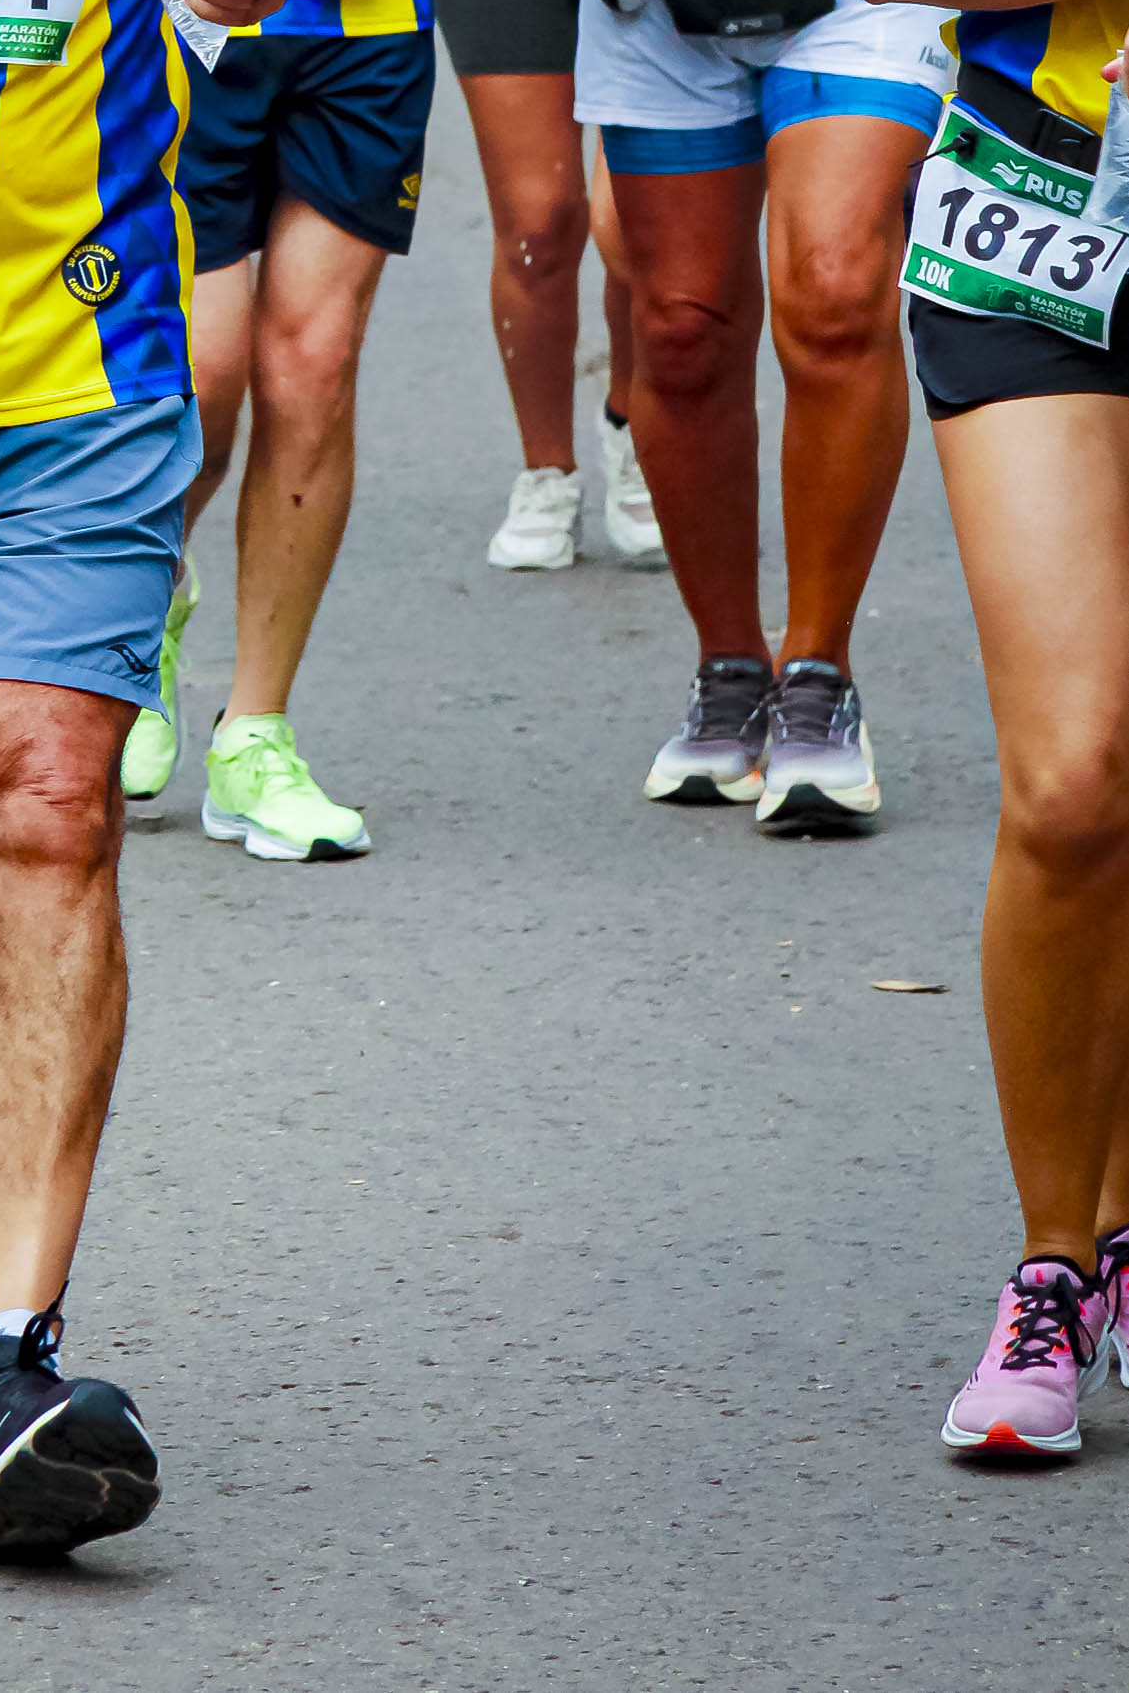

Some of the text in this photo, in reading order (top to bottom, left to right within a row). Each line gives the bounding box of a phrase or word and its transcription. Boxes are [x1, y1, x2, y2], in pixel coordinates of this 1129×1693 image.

[1024, 172, 1084, 211] RUS
[938, 186, 1107, 293] 1813
[915, 255, 955, 293] 10K
